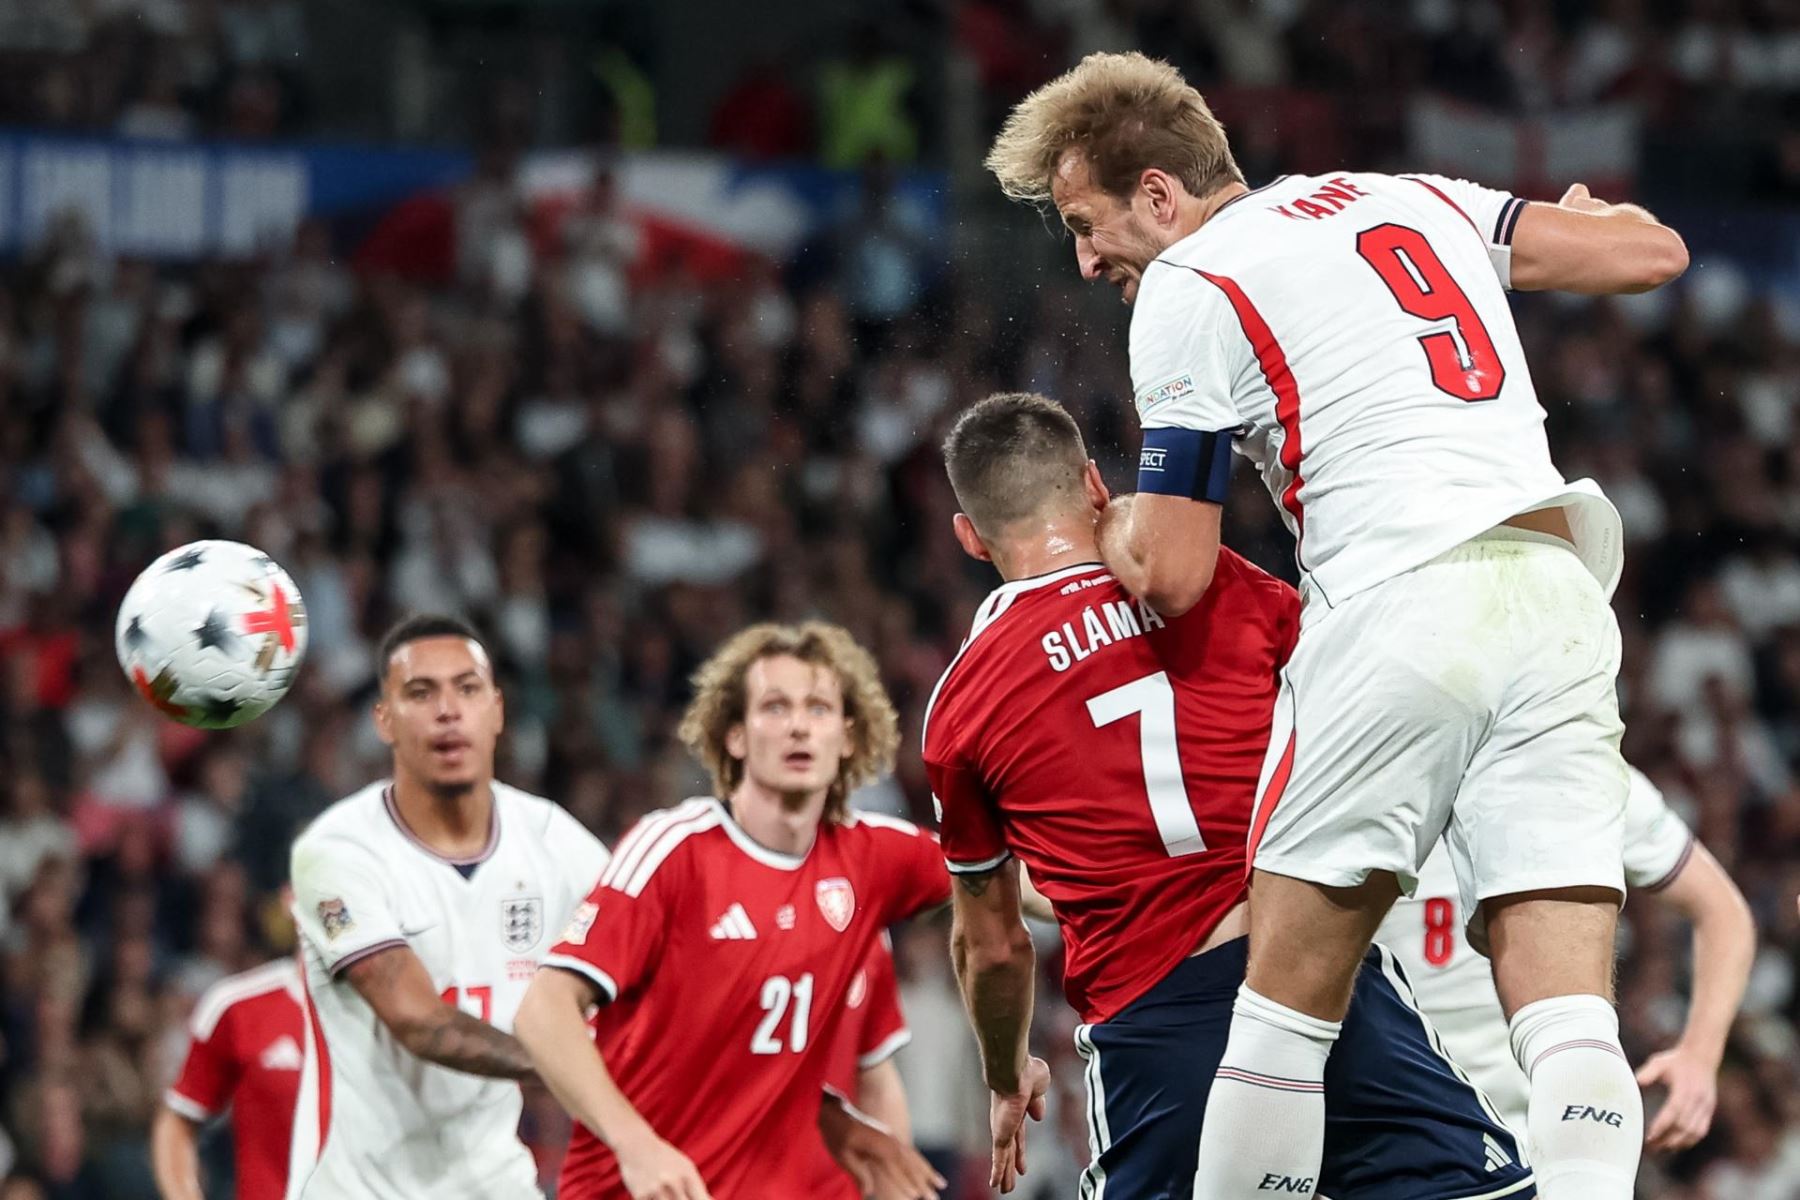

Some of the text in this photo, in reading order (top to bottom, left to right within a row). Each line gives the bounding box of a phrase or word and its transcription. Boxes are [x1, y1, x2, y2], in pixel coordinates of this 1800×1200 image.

[1264, 177, 1372, 220] KANE
[1356, 222, 1505, 401] 9
[1141, 377, 1193, 407] NDATION
[1139, 452, 1167, 467] PECT
[1041, 598, 1166, 672] SLÁMA
[1086, 671, 1207, 858] 7
[1424, 897, 1454, 967] 8
[751, 972, 814, 1055] 21
[1561, 1105, 1623, 1128] ENG
[1258, 1173, 1314, 1193] ENG
